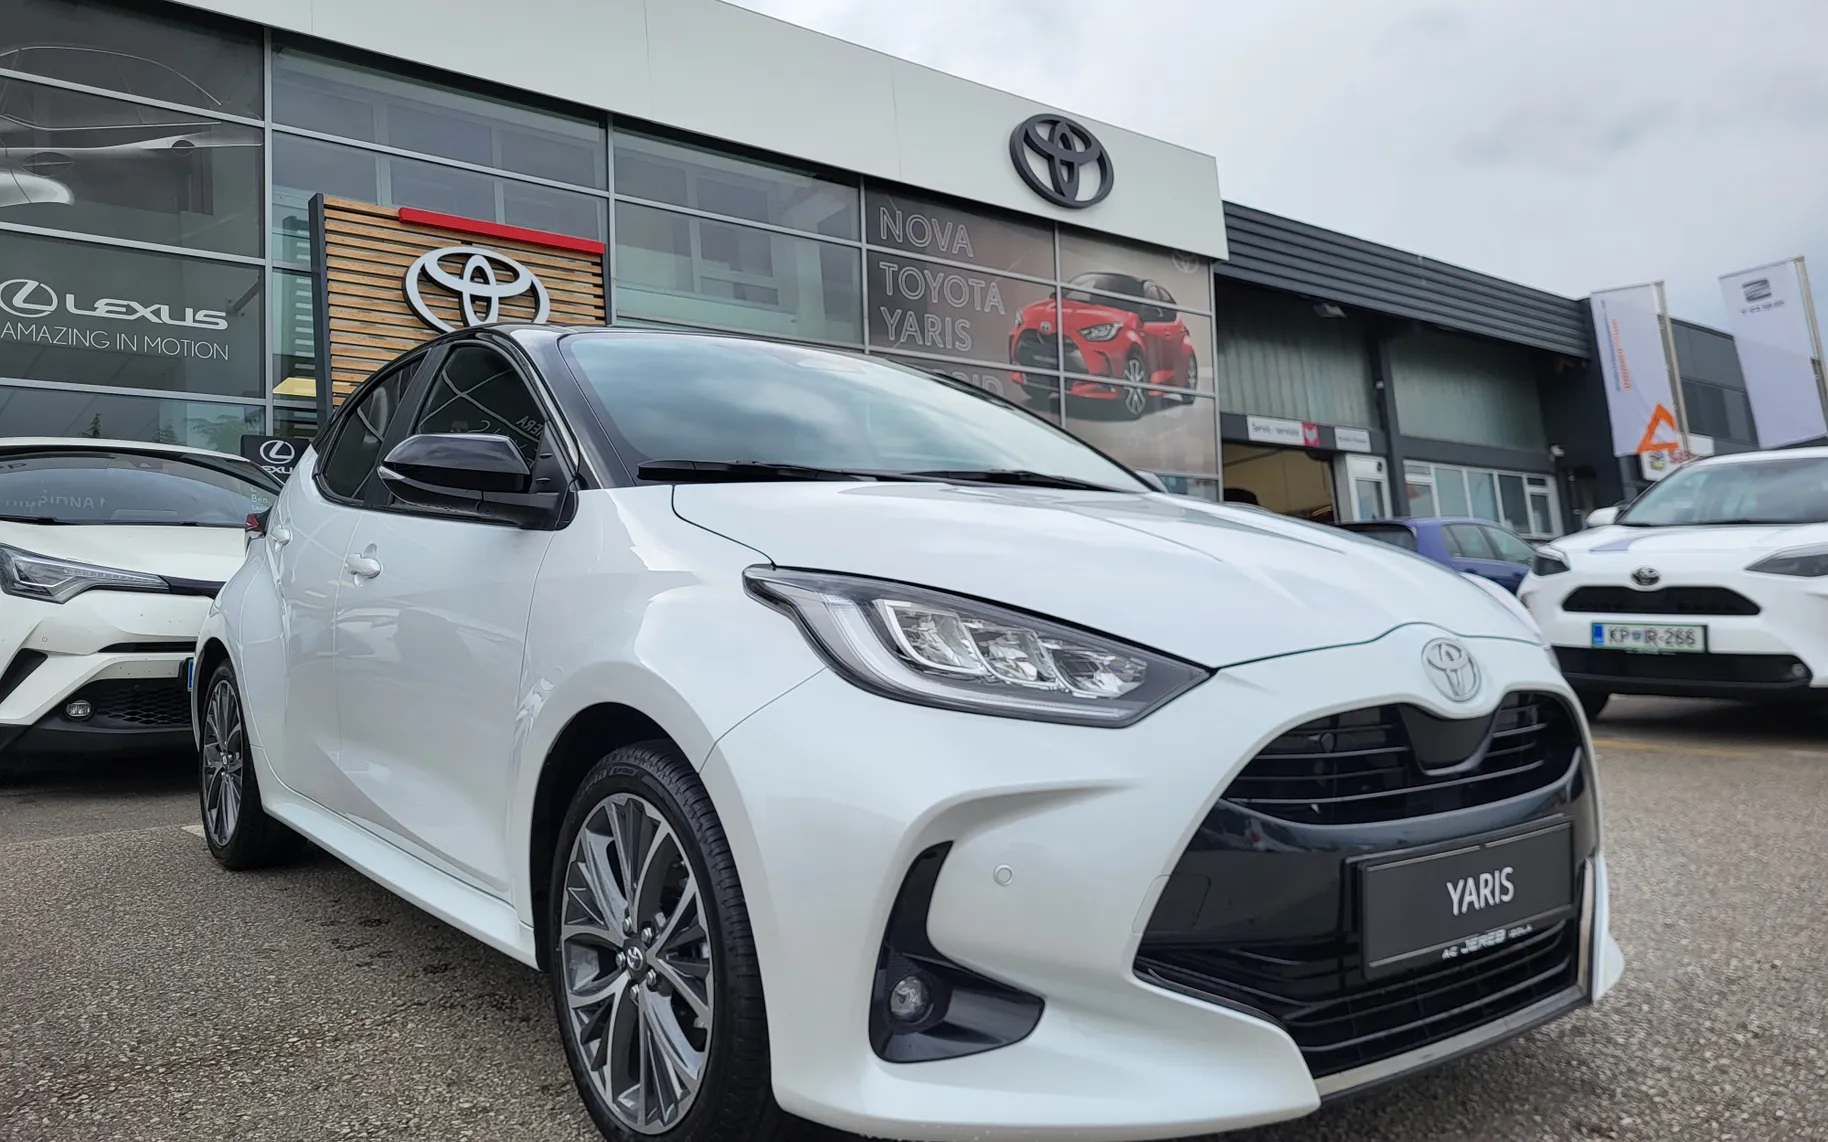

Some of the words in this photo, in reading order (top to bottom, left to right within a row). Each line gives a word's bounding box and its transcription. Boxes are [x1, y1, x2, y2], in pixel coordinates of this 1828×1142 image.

[879, 206, 974, 257] NOVA
[65, 293, 229, 330] LEXUS
[879, 261, 1006, 315] TOYOTA
[0, 321, 110, 350] AMAZING
[116, 333, 138, 352] IN
[144, 335, 229, 361] MOTION
[879, 306, 973, 352] YARIS
[1446, 866, 1515, 917] YARIS
